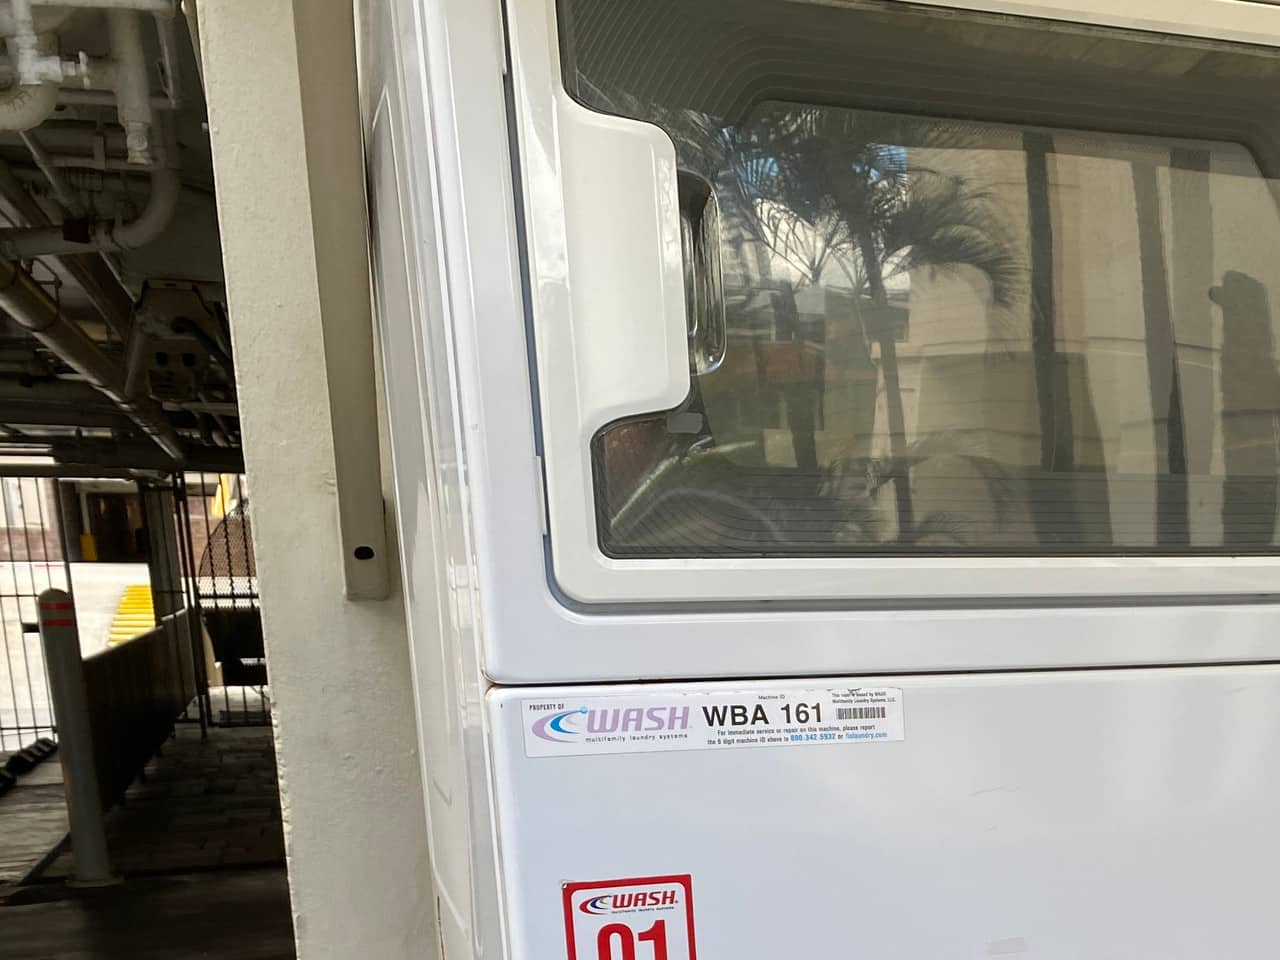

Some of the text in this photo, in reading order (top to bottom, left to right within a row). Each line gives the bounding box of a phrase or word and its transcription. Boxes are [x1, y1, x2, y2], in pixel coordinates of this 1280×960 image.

[529, 703, 556, 711] PROPERTY
[702, 702, 821, 727] WBA 161
[587, 706, 690, 734] WASH
[585, 735, 626, 743] multifamily
[630, 734, 655, 742] laundry
[612, 890, 676, 909] WASH
